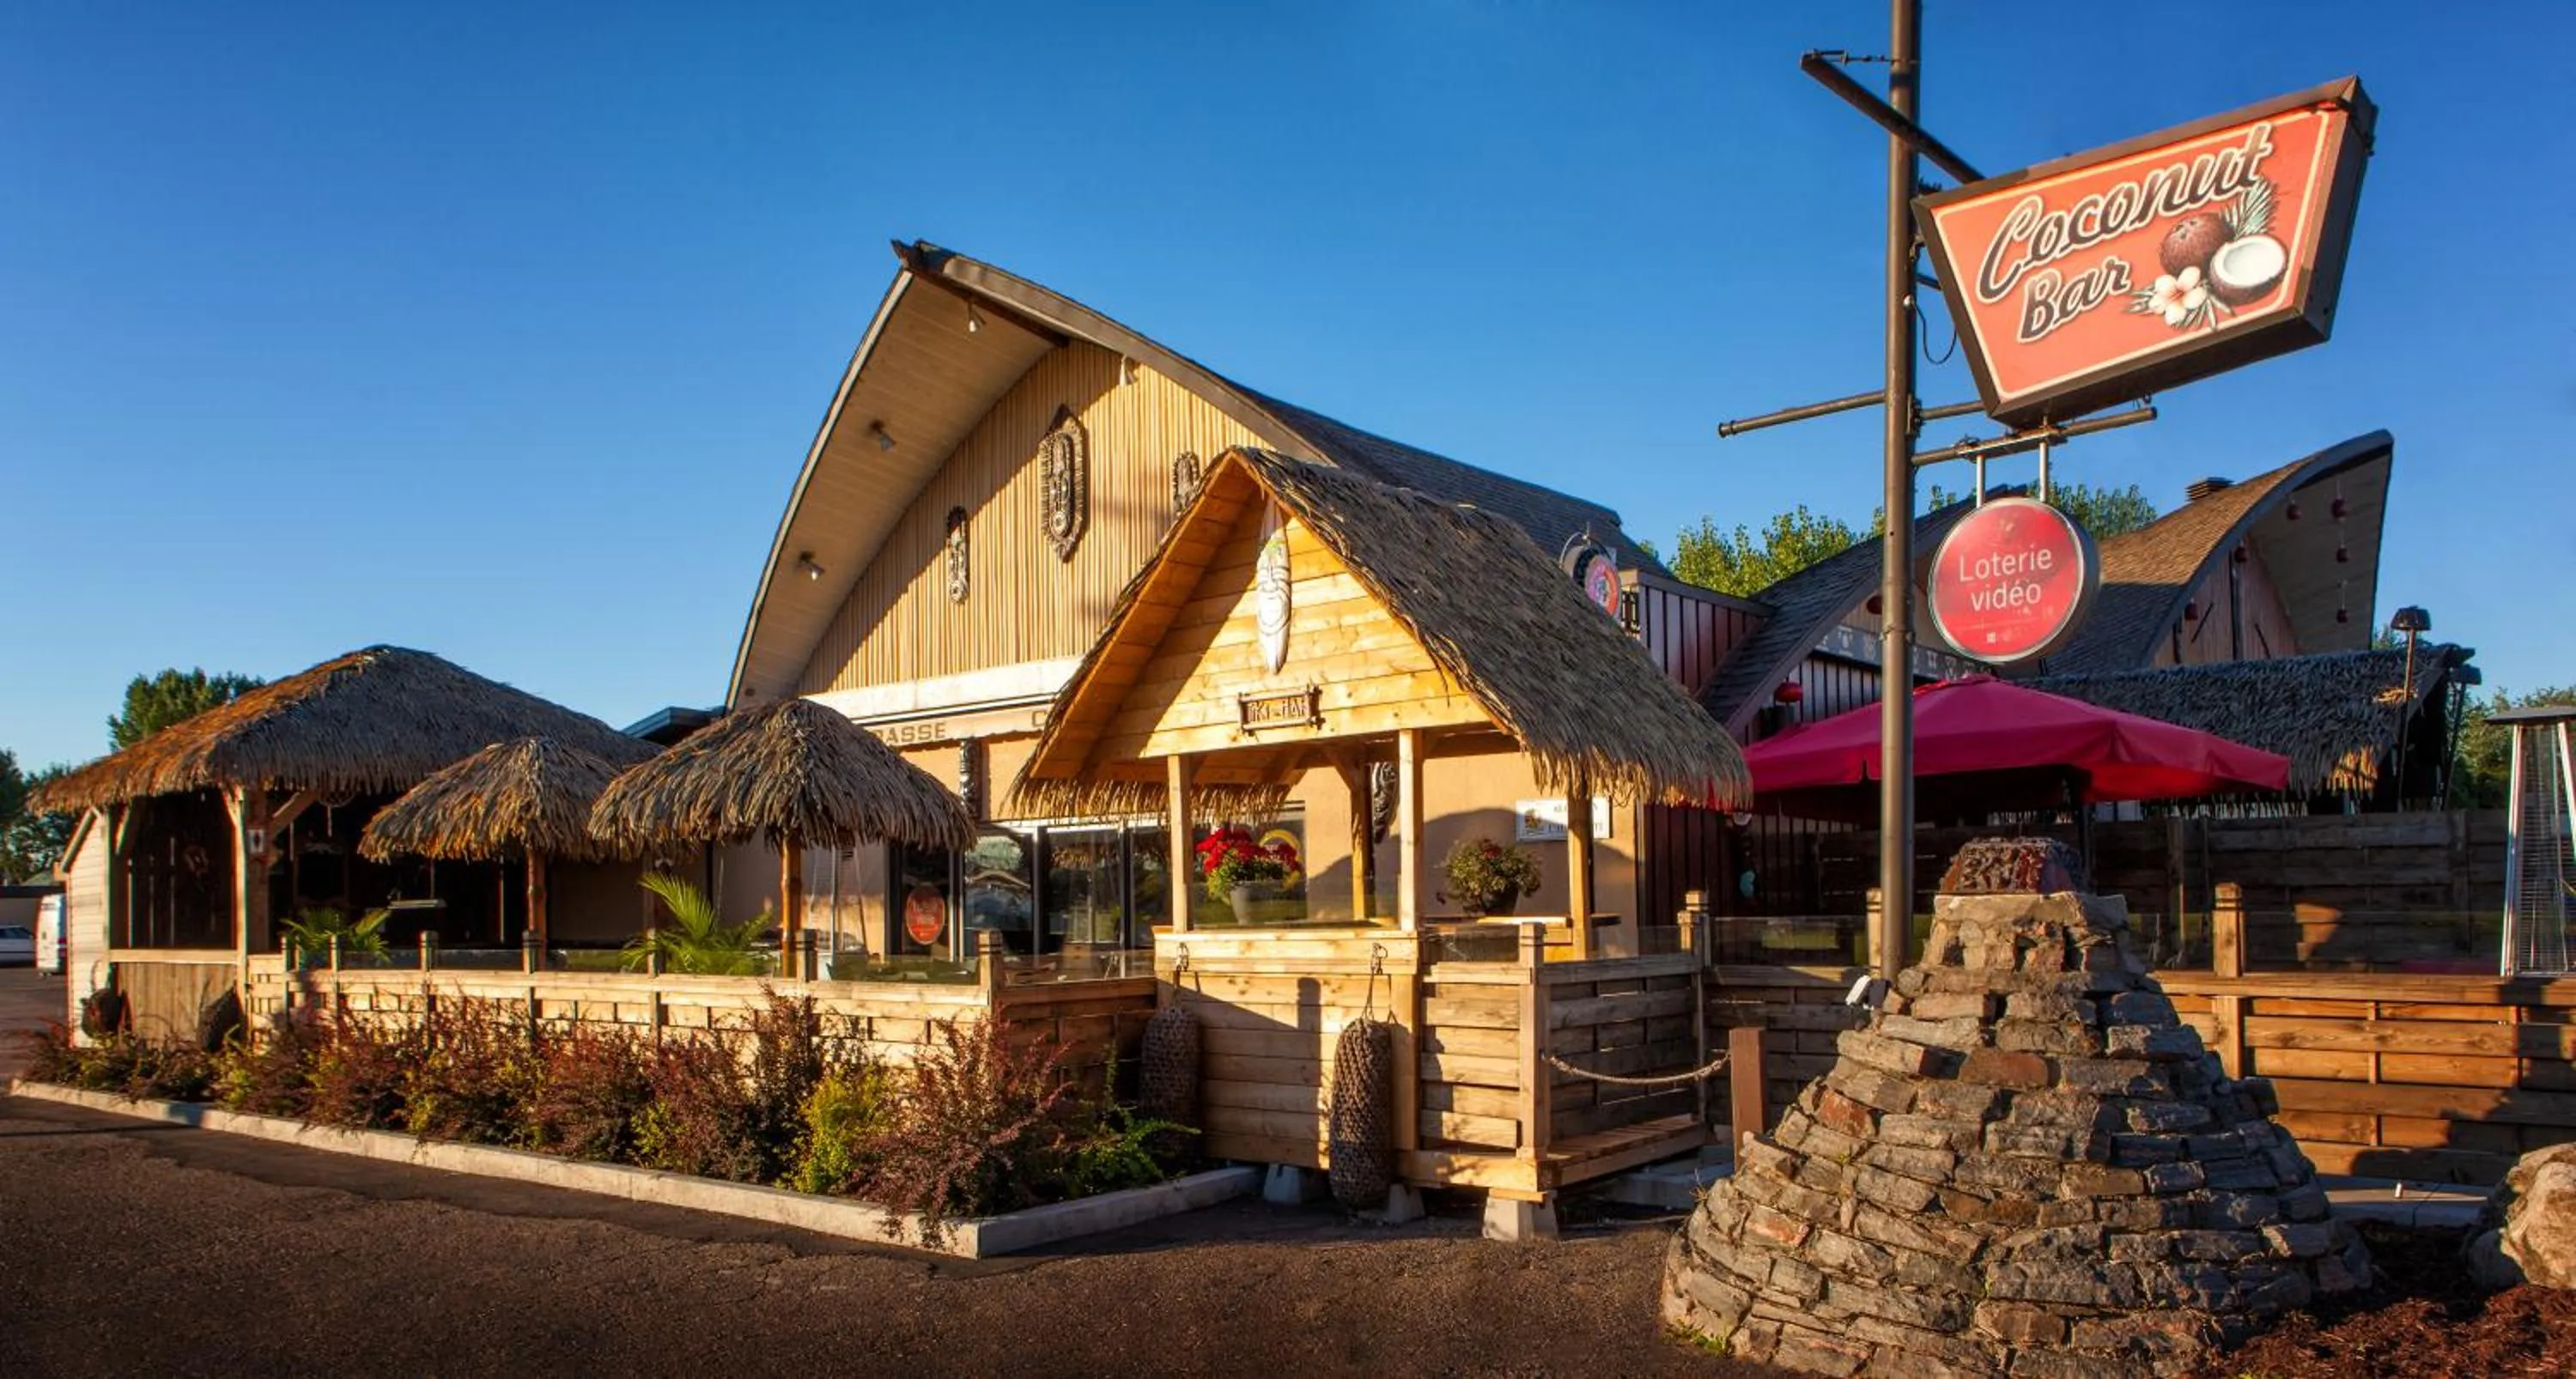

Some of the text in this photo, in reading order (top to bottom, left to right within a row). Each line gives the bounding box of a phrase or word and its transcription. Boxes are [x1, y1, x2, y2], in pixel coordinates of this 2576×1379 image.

[1976, 122, 2274, 305] Coconut
[2016, 256, 2134, 343] Bar
[1959, 543, 2053, 582] Loterie
[1971, 578, 2043, 612] vidéo
